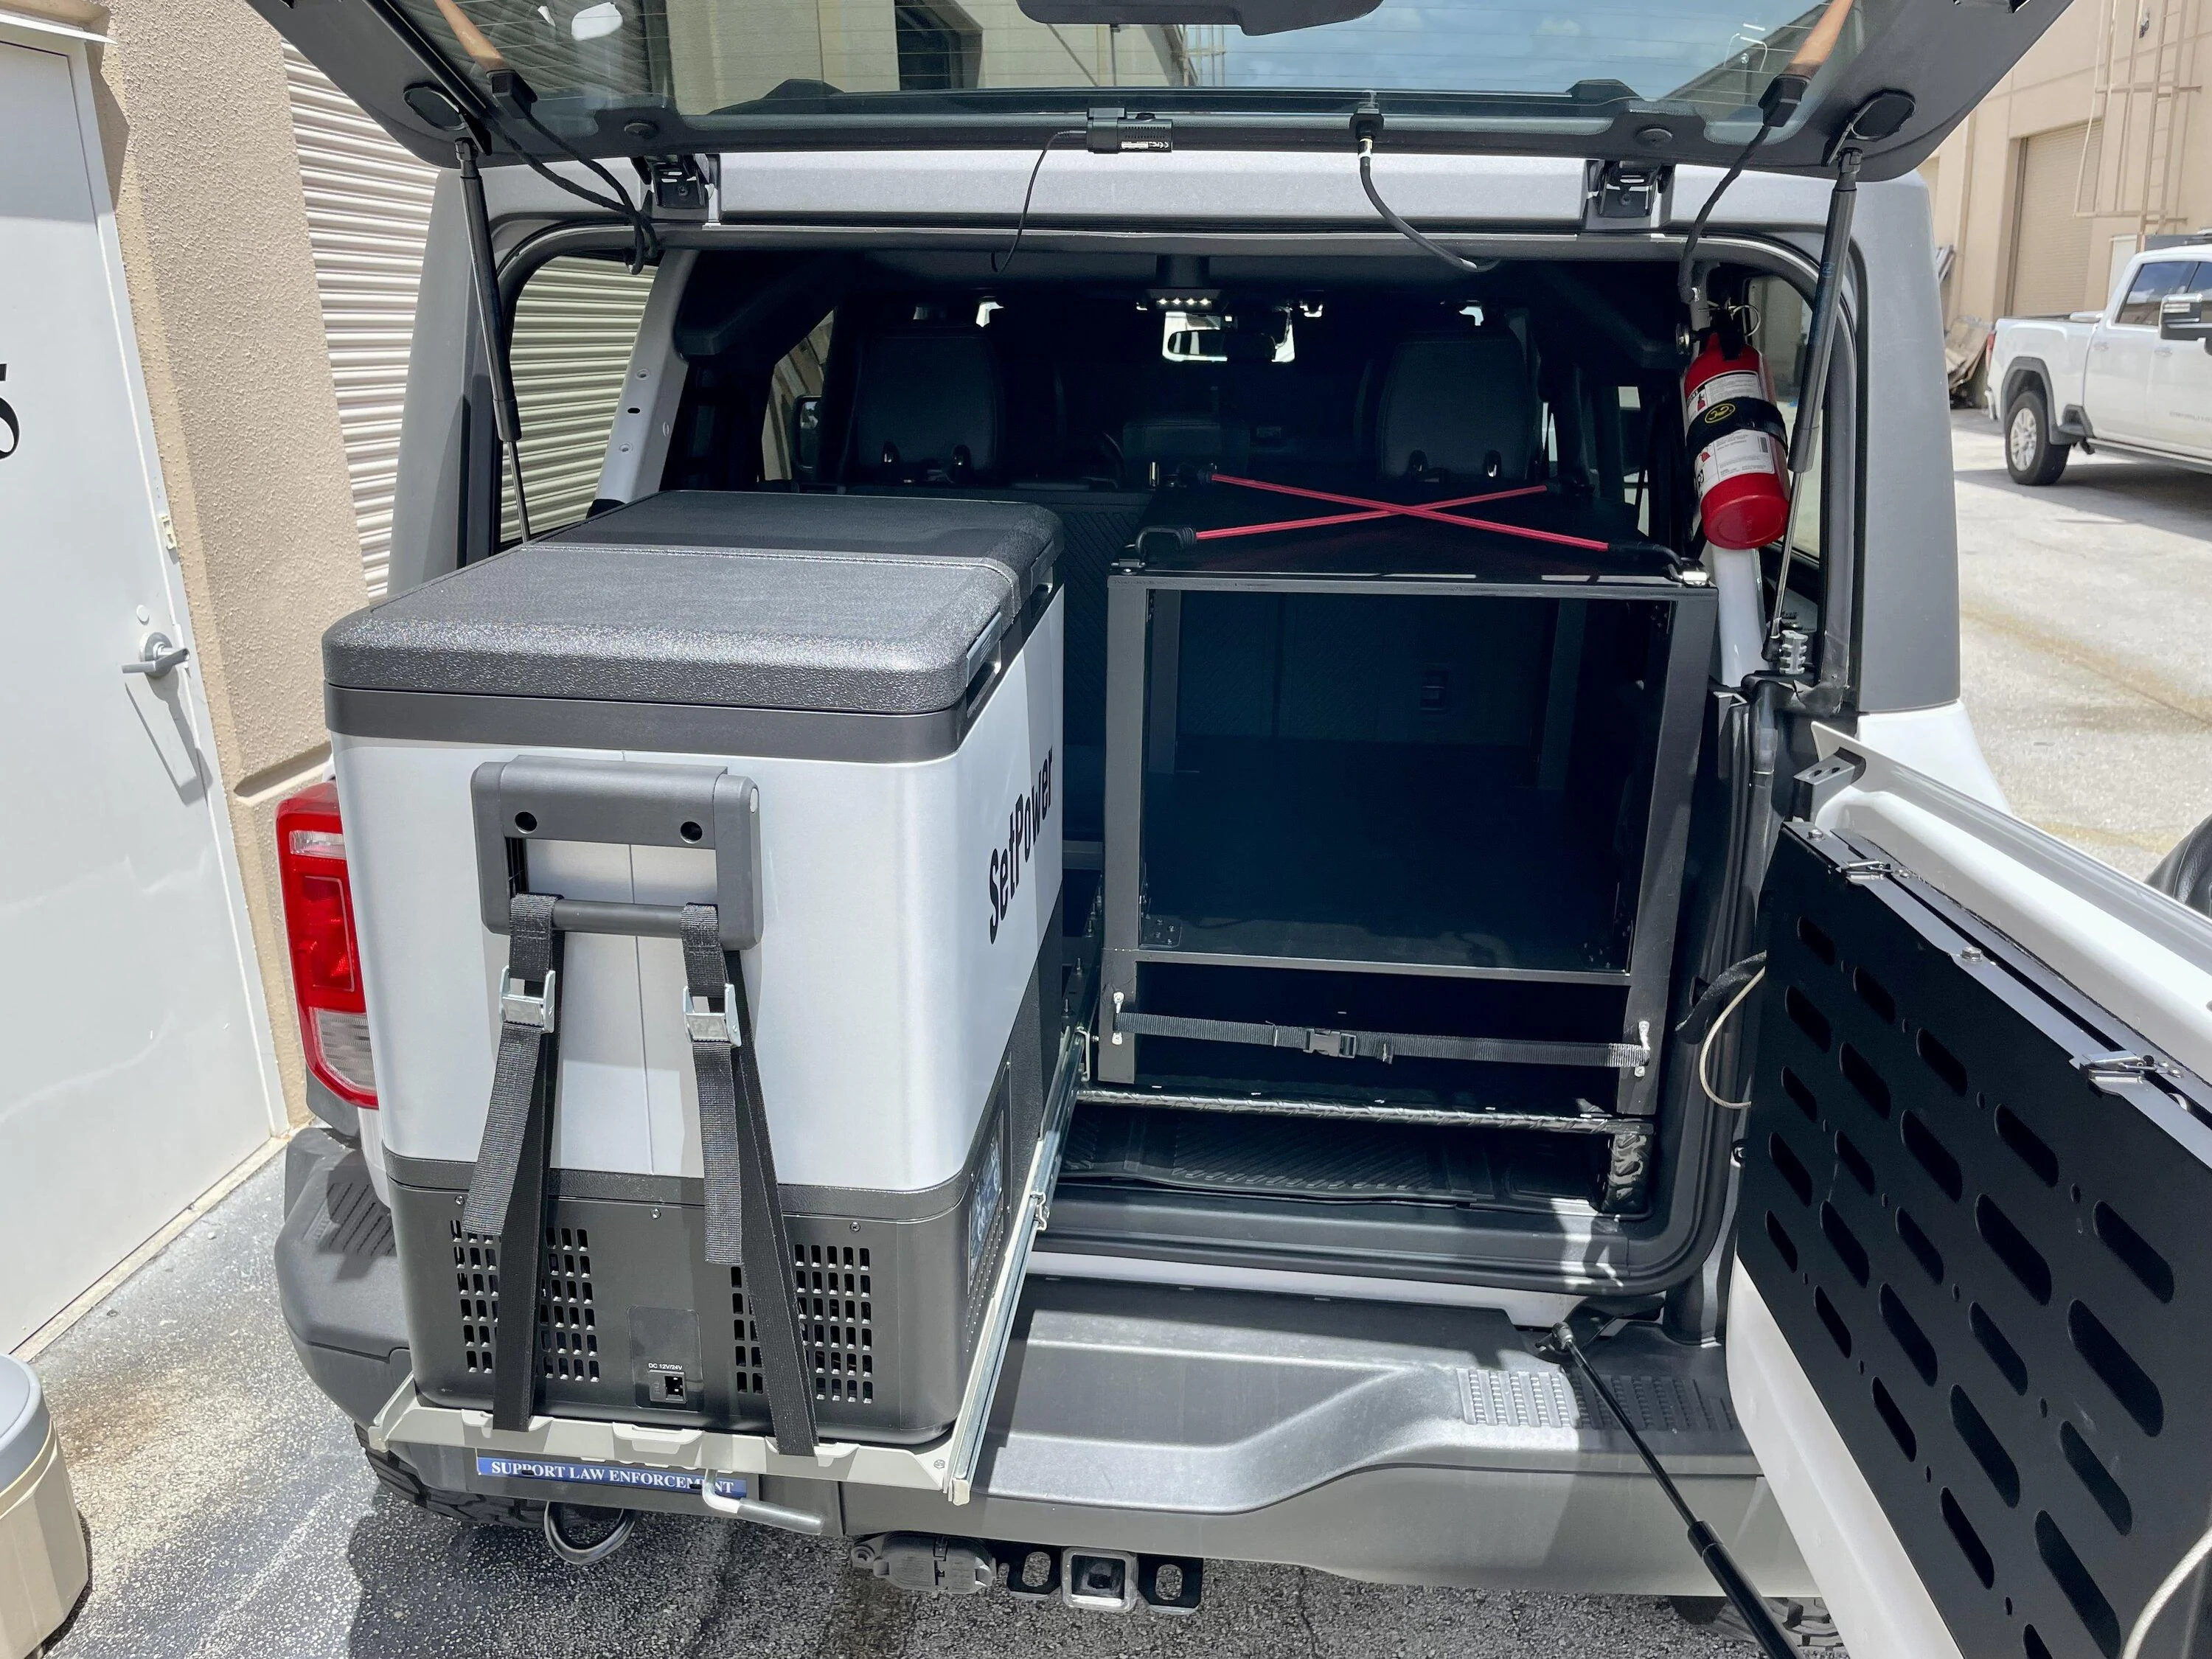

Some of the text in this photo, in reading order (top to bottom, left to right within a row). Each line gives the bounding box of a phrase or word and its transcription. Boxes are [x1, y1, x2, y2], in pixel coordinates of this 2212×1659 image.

[989, 744, 1053, 945] SetPower
[569, 1467, 605, 1481] LAW
[609, 1470, 734, 1493] ENFORCEMNT
